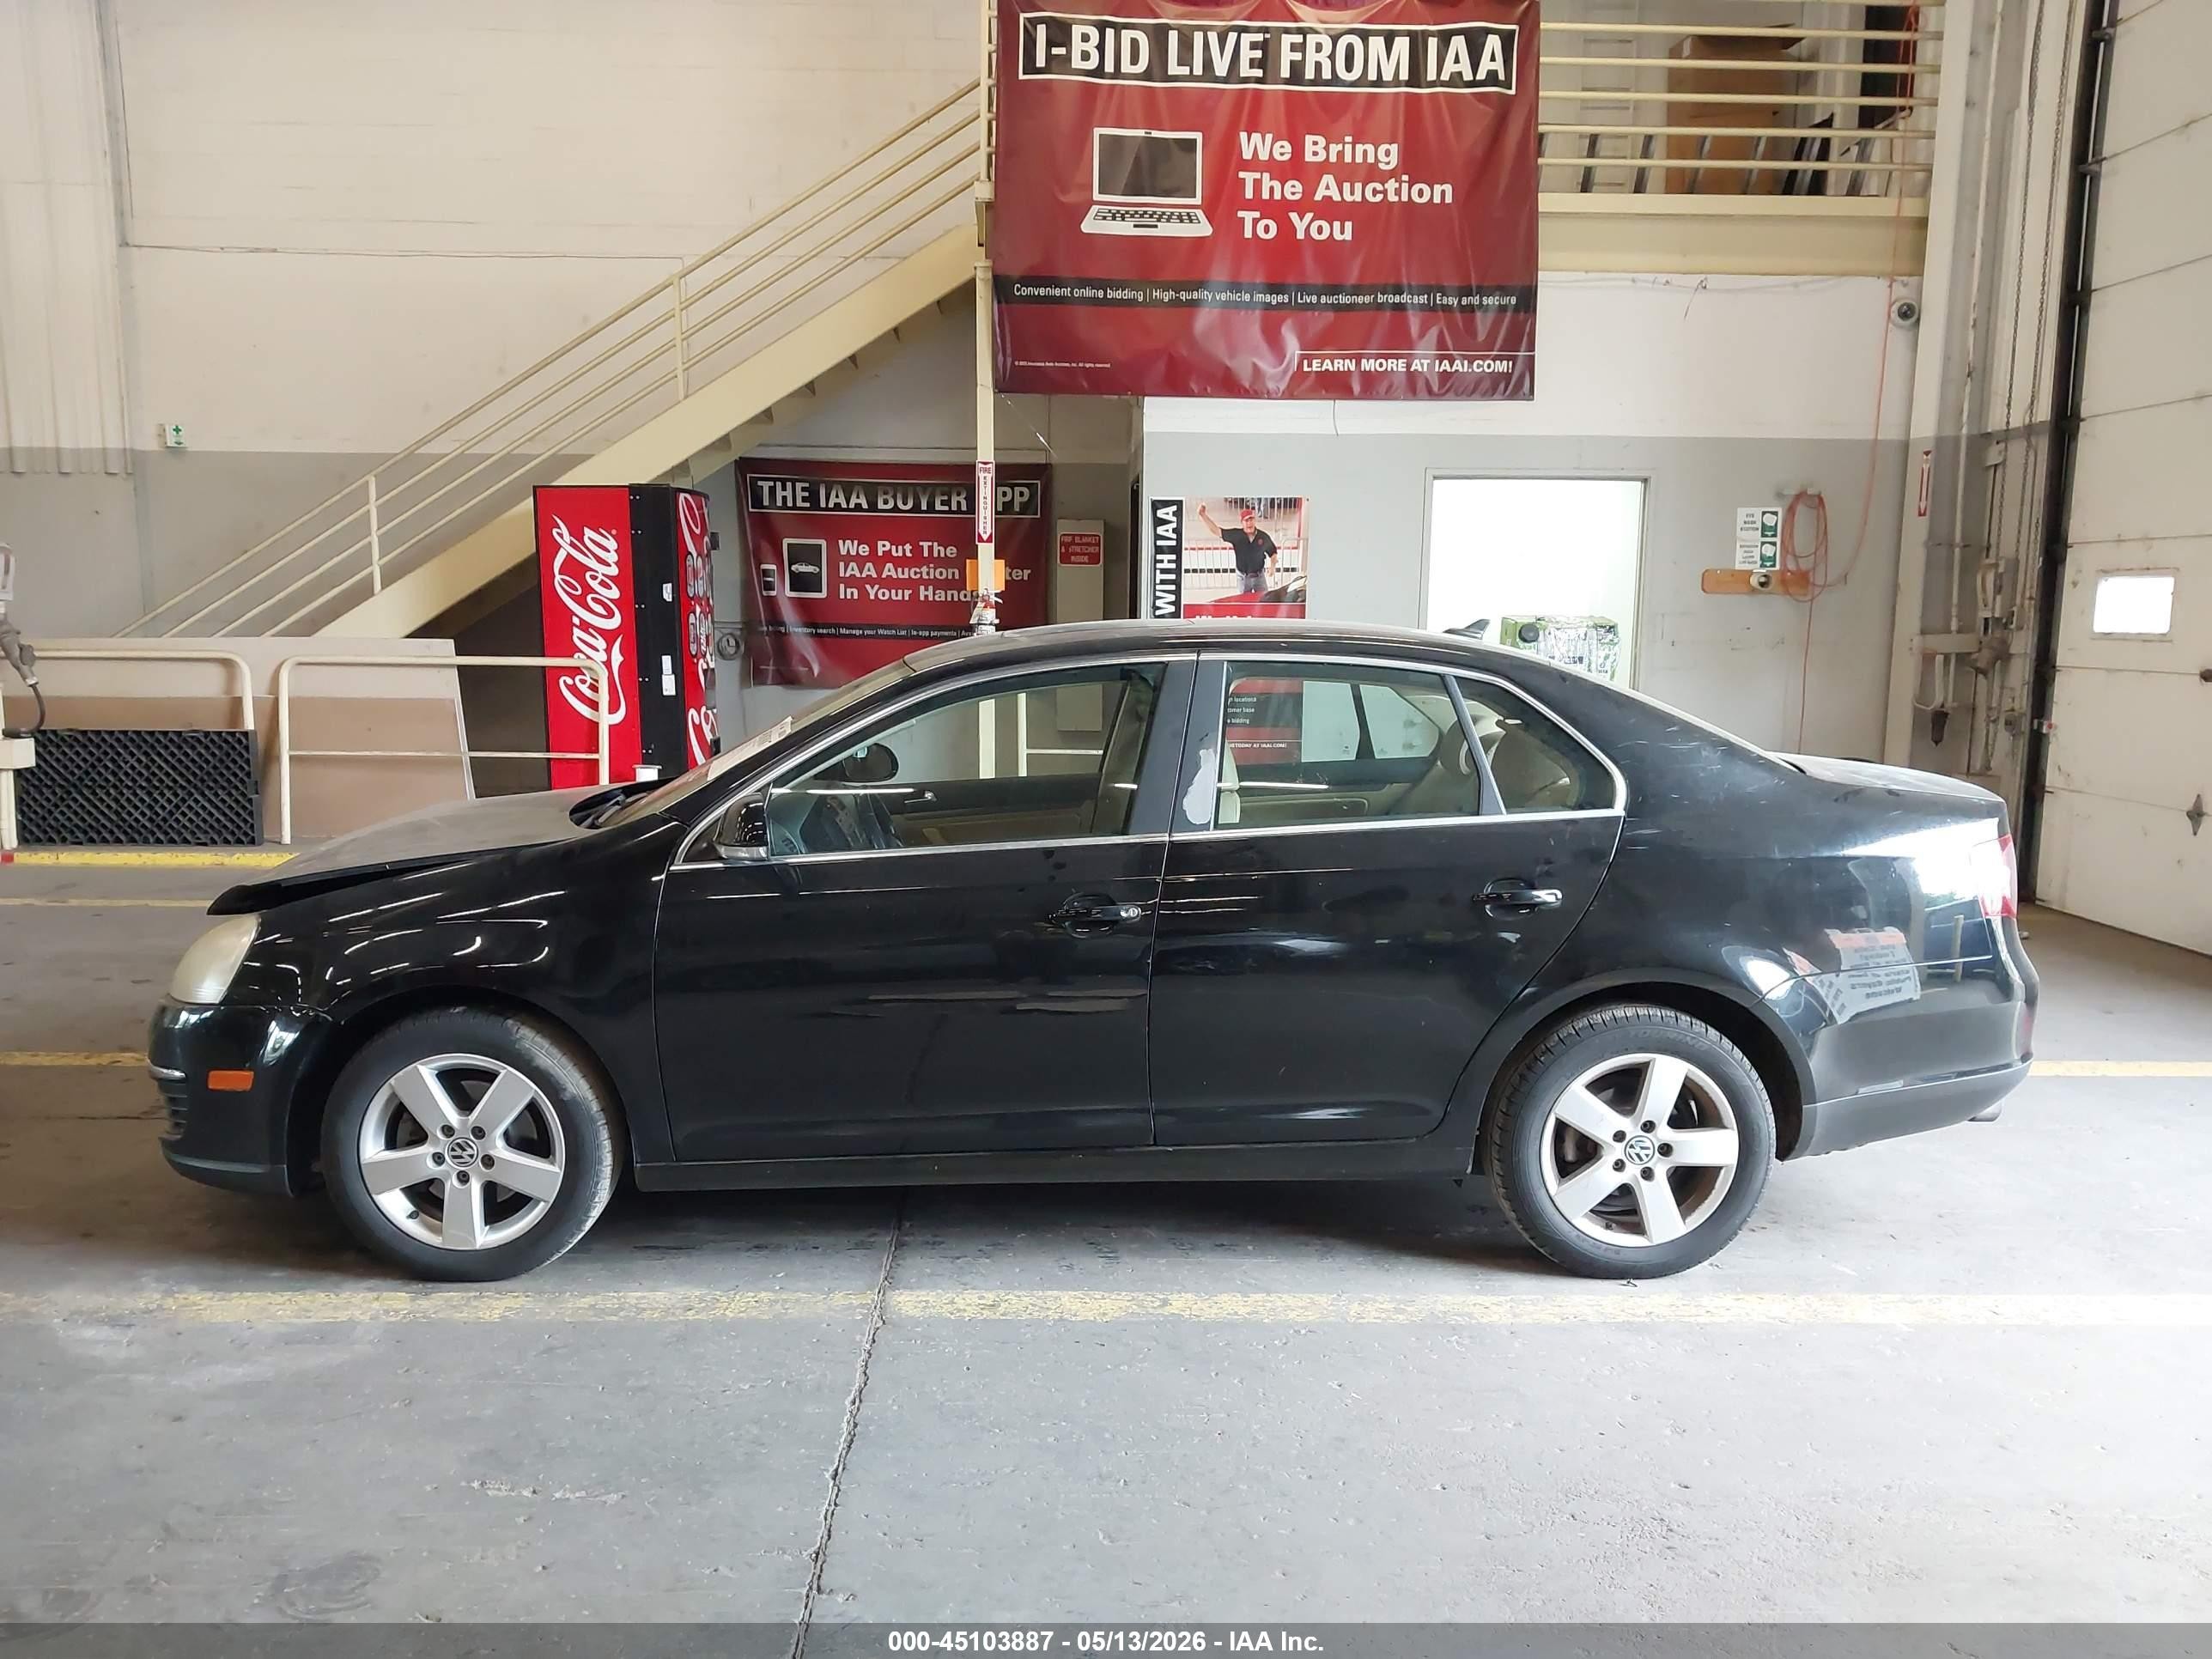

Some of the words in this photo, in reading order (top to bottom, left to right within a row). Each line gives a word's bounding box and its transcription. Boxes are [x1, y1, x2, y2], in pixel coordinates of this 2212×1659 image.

[1036, 24, 1150, 74] I-BID
[1168, 30, 1264, 77] LIVE
[1280, 33, 1410, 82] FROM
[1426, 34, 1506, 82] IAA
[1239, 131, 1292, 161] We
[1304, 134, 1399, 170] Bring
[1237, 171, 1304, 200] The
[1313, 174, 1453, 204] Auction
[1237, 210, 1278, 240] To
[1288, 211, 1352, 240] You
[1014, 283, 1072, 297] Convenient
[1073, 286, 1104, 299] online
[1106, 288, 1144, 301] bidding
[1152, 289, 1212, 303] High-quality
[1215, 290, 1250, 302] vehicle
[1253, 291, 1289, 304] images
[1297, 291, 1317, 304] Live
[1320, 292, 1375, 304] auctioneer
[1377, 291, 1428, 304] broadcast
[1436, 292, 1458, 307] Easy
[1462, 293, 1480, 305] and
[1482, 295, 1516, 306] secure
[1303, 359, 1356, 372] LEARN
[1360, 359, 1407, 372] MORE
[1410, 359, 1431, 372] AT
[1435, 359, 1512, 373] IAAI.COM!
[757, 481, 811, 507] THE
[819, 483, 869, 510] IAA
[877, 485, 968, 513] BUYER
[997, 486, 1030, 513] PP
[1156, 505, 1177, 546] IAA
[838, 539, 870, 556] We
[877, 540, 912, 557] Put
[919, 541, 957, 558] The
[838, 562, 877, 579] IAA
[882, 562, 959, 580] Auction
[1005, 565, 1031, 581] ter
[1155, 554, 1177, 617] WITH
[839, 584, 859, 599] In
[865, 584, 913, 601] Your
[839, 627, 863, 637] Manage
[864, 629, 877, 637] your
